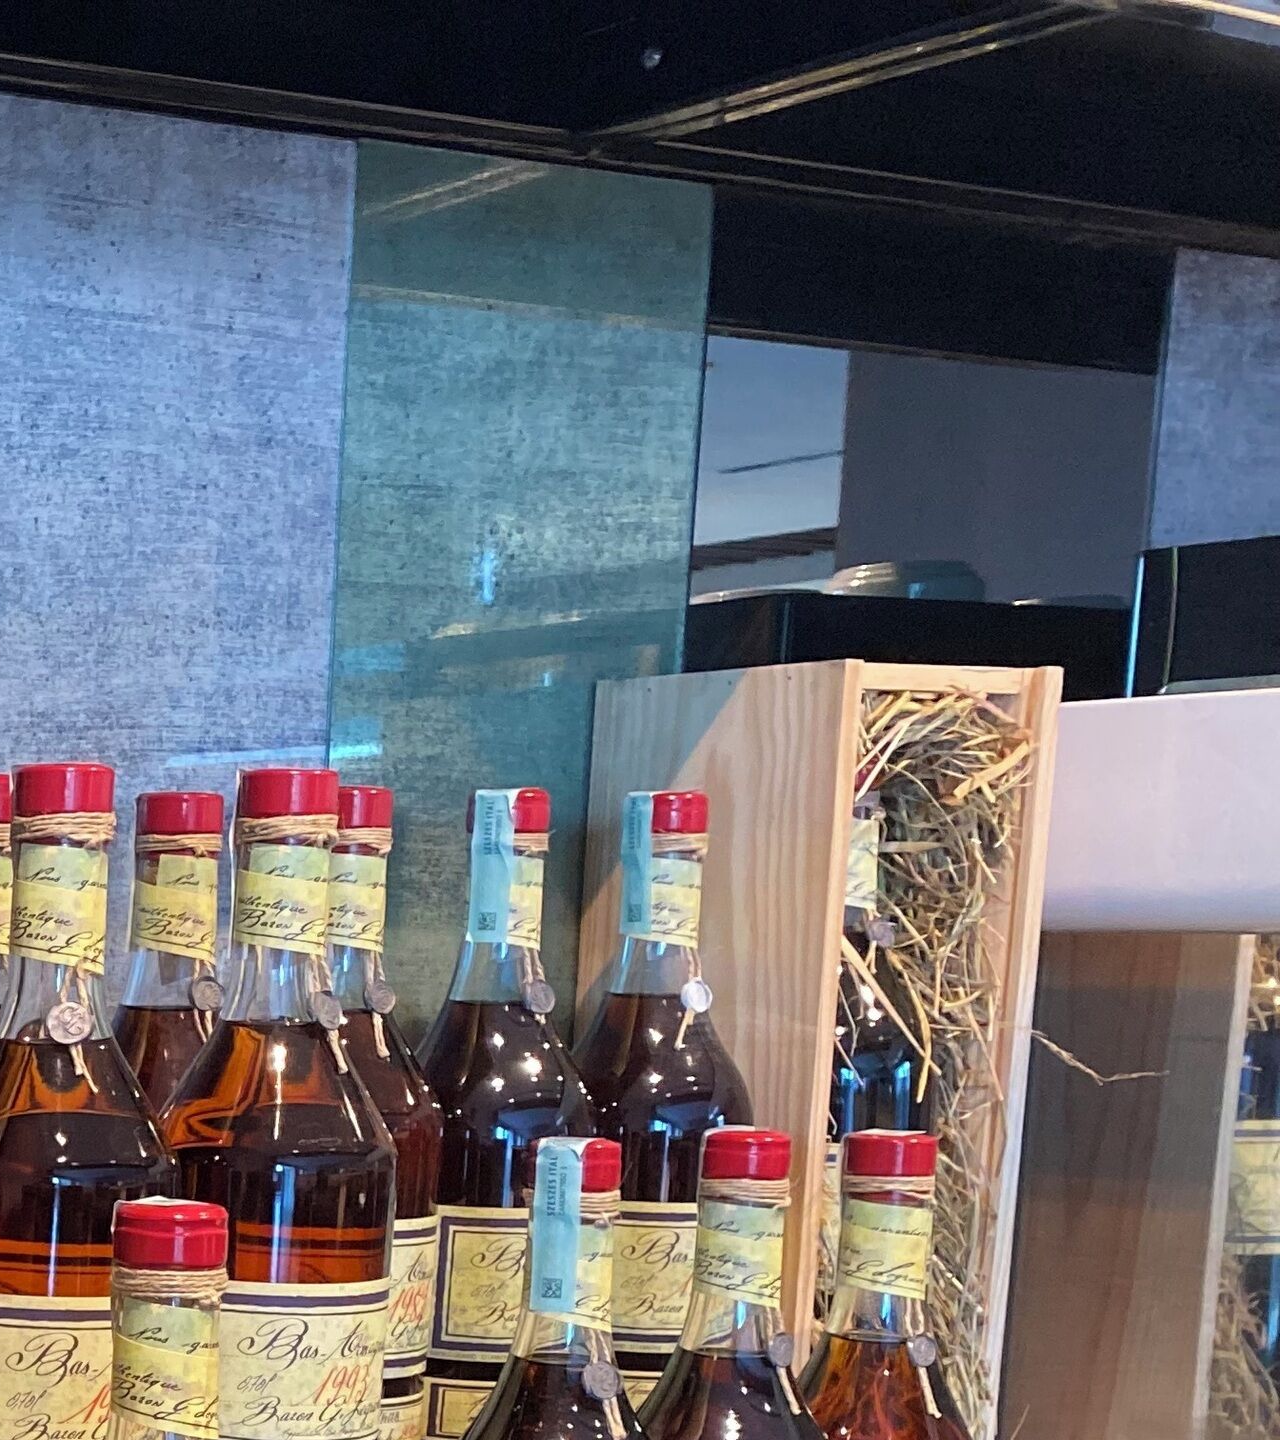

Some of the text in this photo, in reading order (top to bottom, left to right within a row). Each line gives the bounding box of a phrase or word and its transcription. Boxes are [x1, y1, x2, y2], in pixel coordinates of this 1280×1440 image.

[547, 1177, 557, 1217] SZESZES
[114, 1378, 164, 1407] Baron
[312, 1363, 372, 1405] 1993
[243, 1395, 318, 1426] Baron
